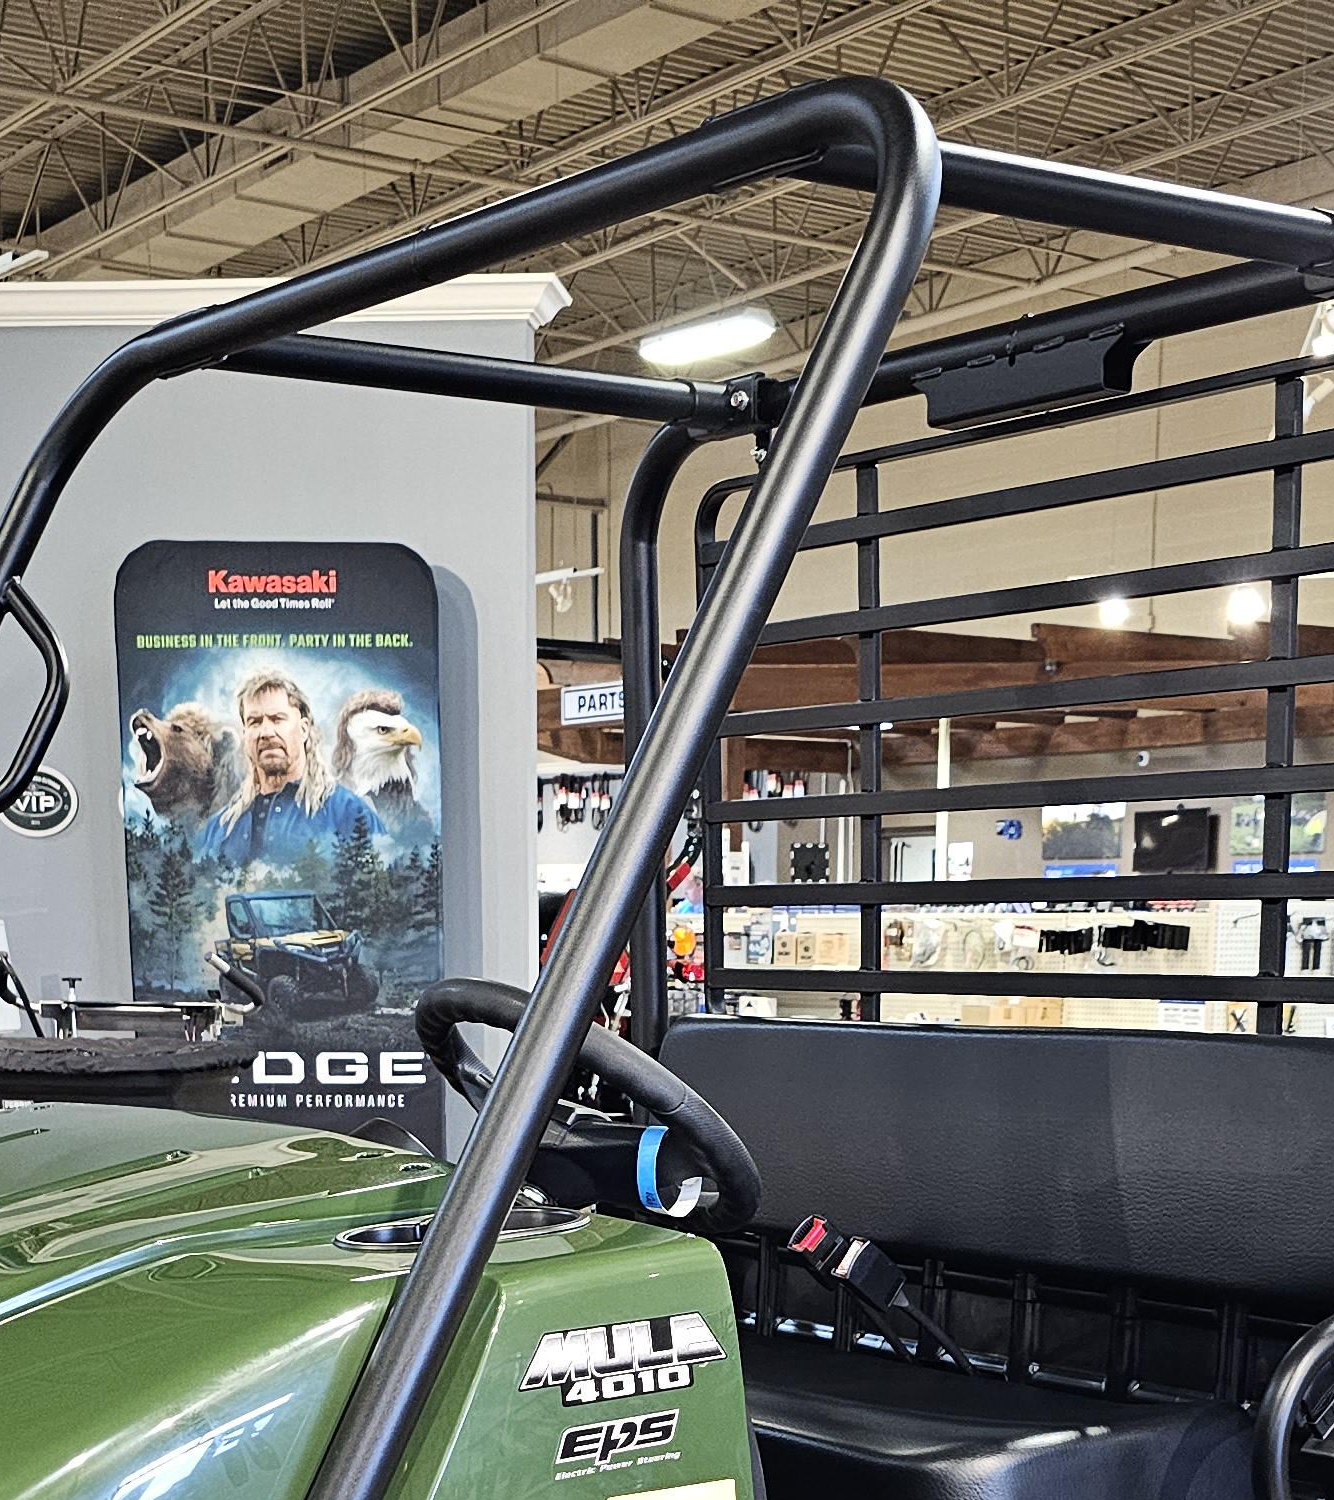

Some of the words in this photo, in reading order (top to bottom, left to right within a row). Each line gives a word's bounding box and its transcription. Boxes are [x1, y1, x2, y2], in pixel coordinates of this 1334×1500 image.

[208, 569, 337, 594] Kawasaki
[213, 598, 231, 609] Let
[232, 598, 250, 609] the
[251, 598, 279, 609] Good
[279, 598, 310, 609] Times
[136, 634, 197, 649] BUSINESS
[200, 634, 213, 648] IN
[216, 633, 240, 648] THE
[242, 633, 286, 648] FRONT.
[289, 633, 330, 648] PARTY
[332, 633, 346, 648] IN
[349, 633, 373, 648] THE
[375, 633, 414, 648] BACK.
[578, 691, 625, 713] PARTS
[16, 795, 55, 812] VIP
[231, 1050, 427, 1084] DGE
[231, 1093, 287, 1108] REMIUM
[296, 1093, 406, 1108] PERFORMANCE
[519, 1311, 727, 1392] MULE
[565, 1366, 693, 1404] 4010
[554, 1466, 597, 1480] Electric
[599, 1459, 634, 1472] Power
[637, 1451, 682, 1465] Steering
